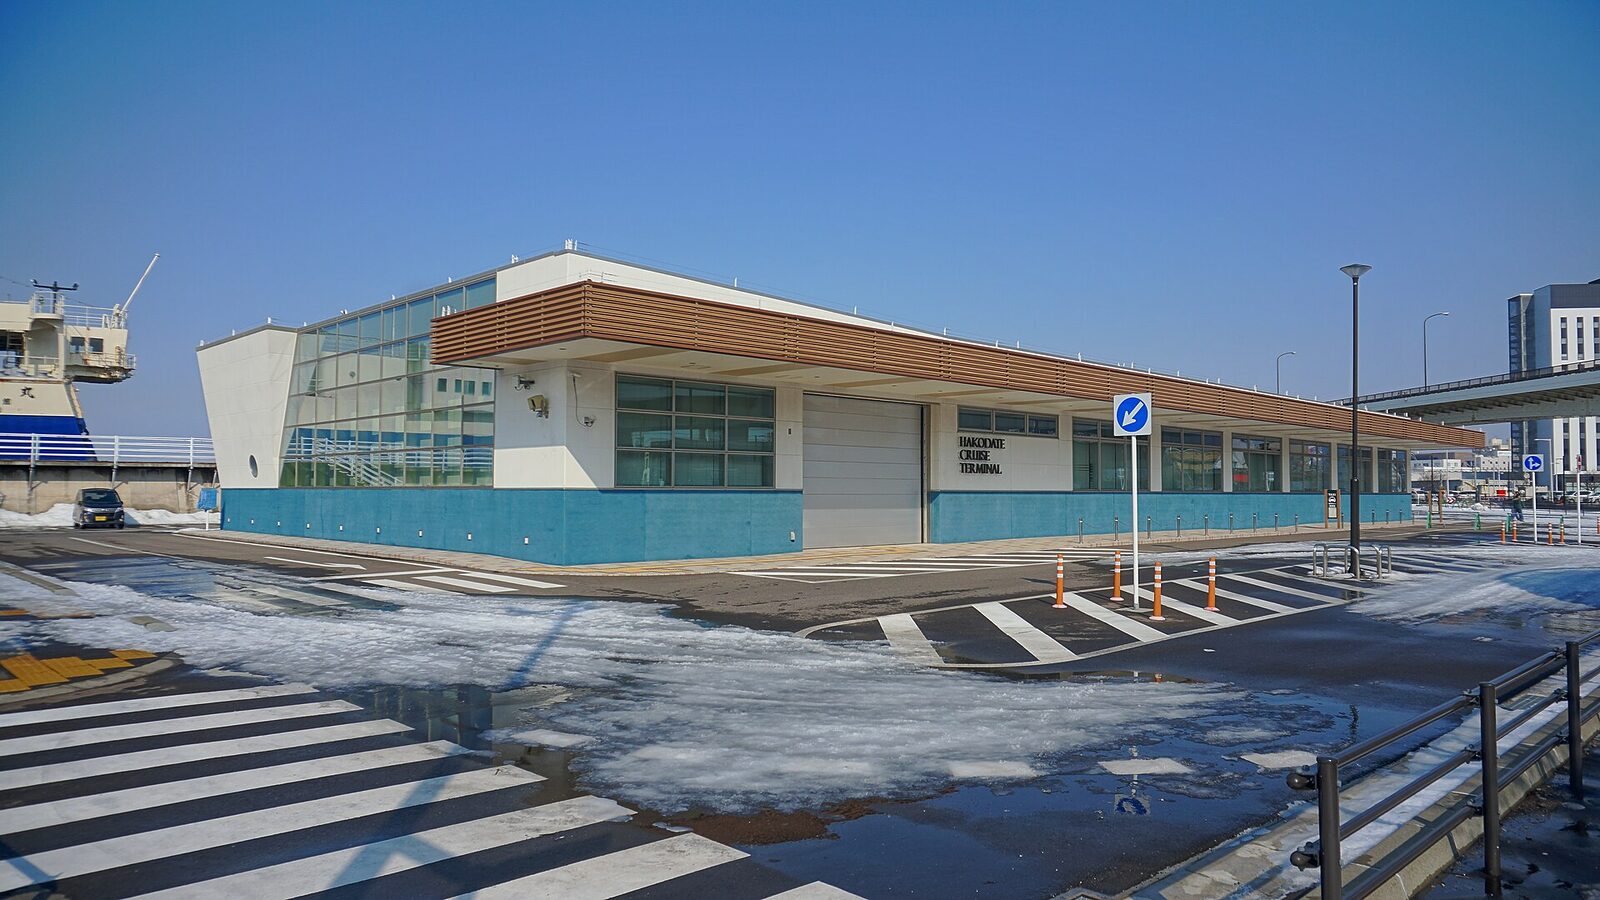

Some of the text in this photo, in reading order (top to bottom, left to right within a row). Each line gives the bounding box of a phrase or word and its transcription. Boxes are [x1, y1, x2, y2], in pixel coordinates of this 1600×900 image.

[959, 436, 1005, 449] HAKODATE
[959, 449, 990, 461] CRUISE
[959, 463, 1002, 474] TERMINAL
